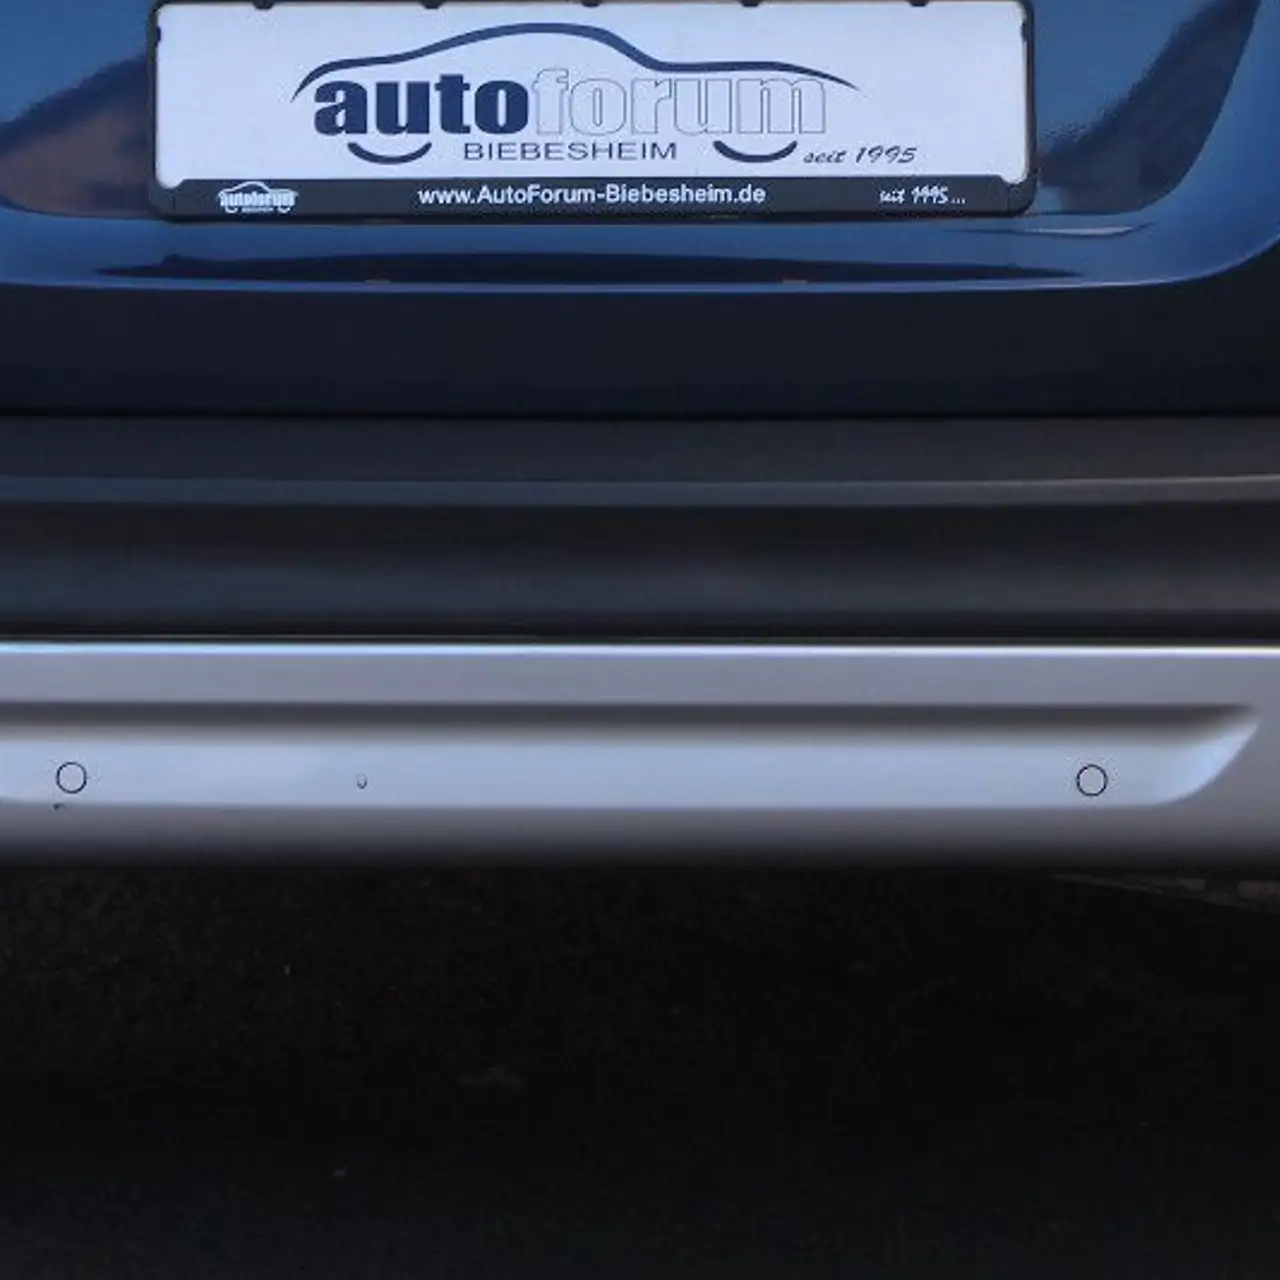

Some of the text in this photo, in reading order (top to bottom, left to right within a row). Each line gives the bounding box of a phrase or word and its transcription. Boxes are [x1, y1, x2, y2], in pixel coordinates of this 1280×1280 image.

[463, 141, 679, 161] BIEBESHEIM
[802, 145, 919, 165] seit 1995
[417, 182, 767, 207] www.AutoForum-Biebesheim.de
